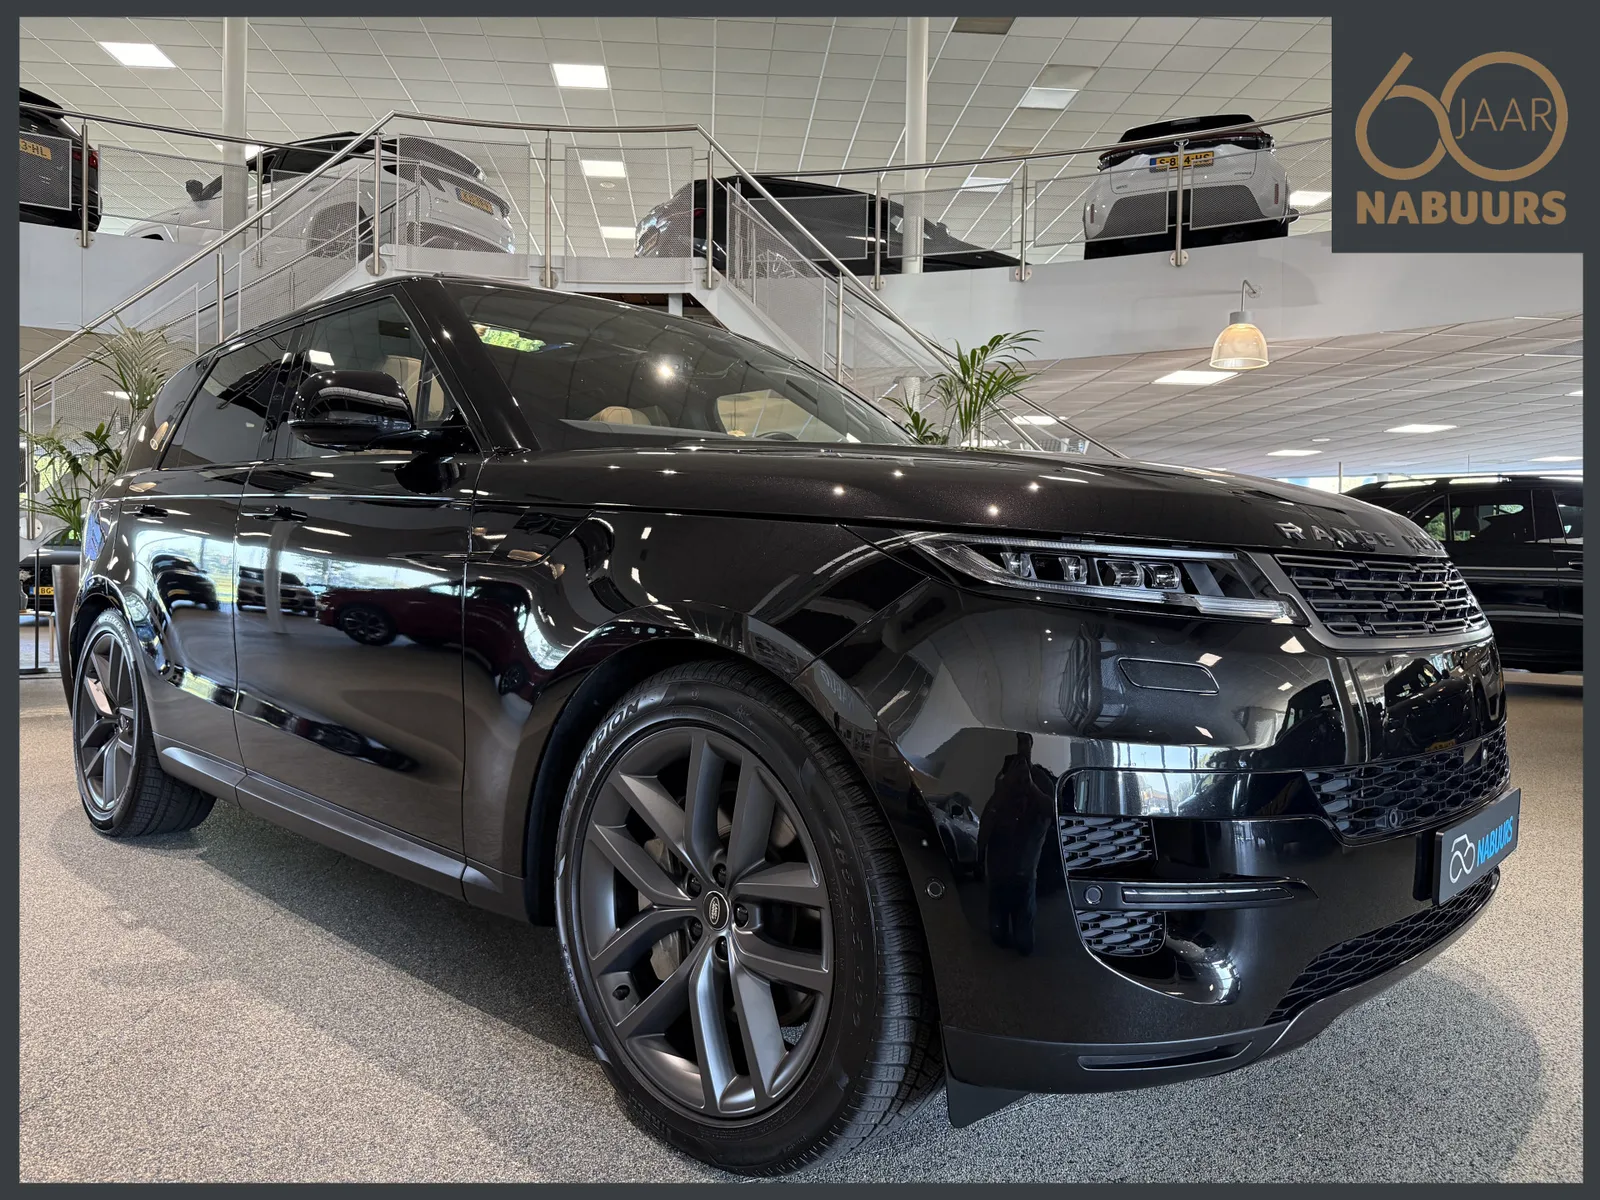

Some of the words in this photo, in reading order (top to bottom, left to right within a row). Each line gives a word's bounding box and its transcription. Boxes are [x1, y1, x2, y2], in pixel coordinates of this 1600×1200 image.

[1159, 153, 1210, 168] S-84-HS
[1274, 522, 1396, 548] RANGE
[1476, 816, 1514, 868] NABUURS
